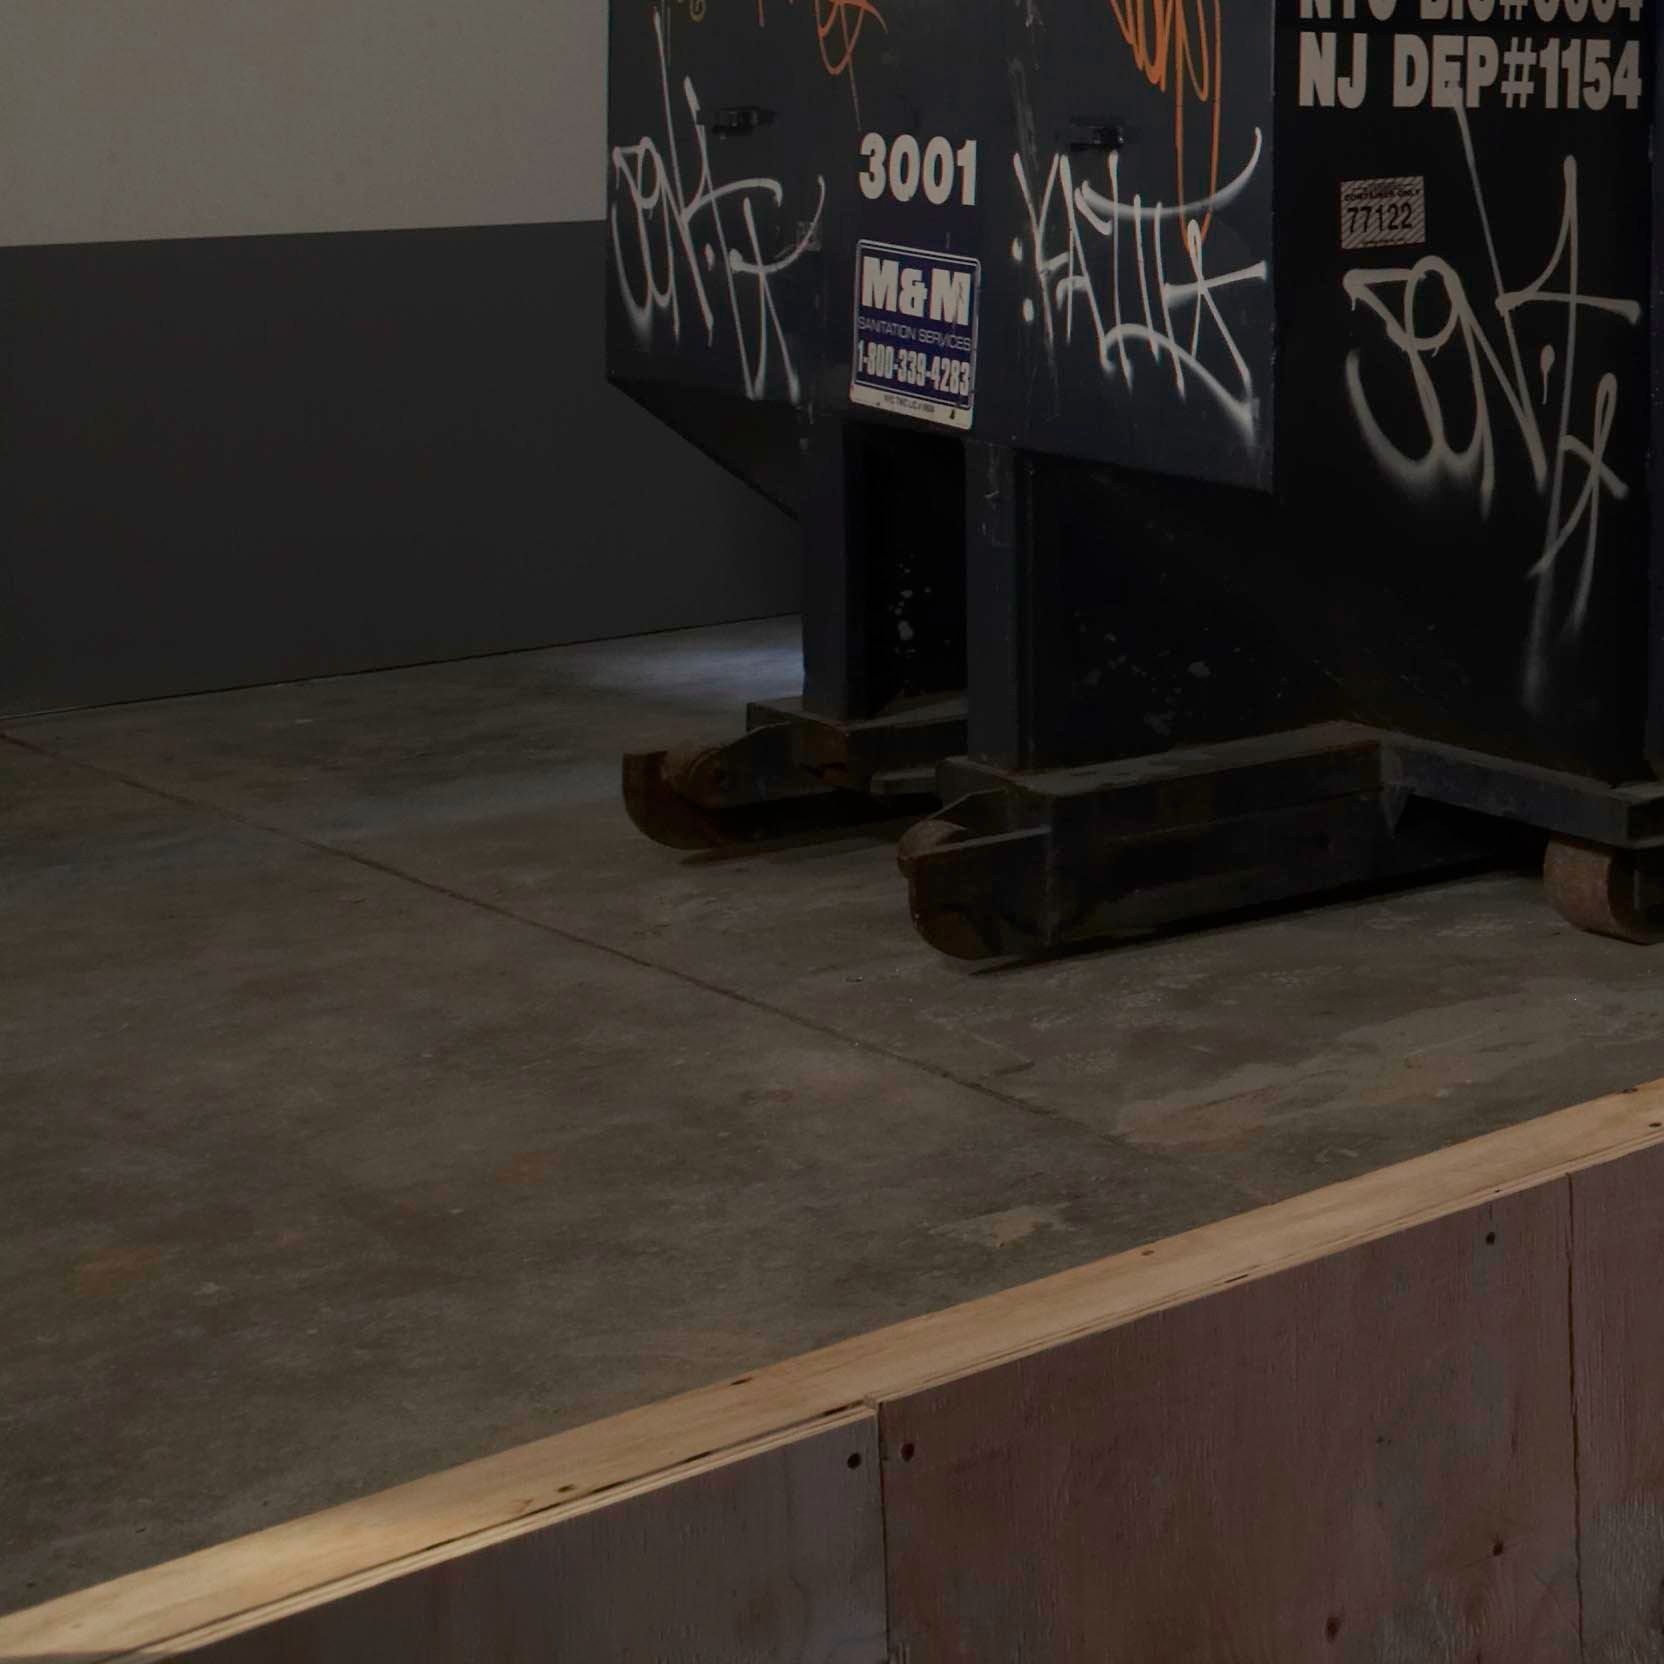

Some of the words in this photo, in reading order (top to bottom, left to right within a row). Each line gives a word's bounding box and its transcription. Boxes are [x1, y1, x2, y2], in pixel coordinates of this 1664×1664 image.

[1299, 31, 1367, 109] NJ
[1393, 33, 1642, 110] DEP#1154
[860, 133, 978, 206] 3001
[1347, 202, 1413, 235] 77122
[862, 256, 971, 326] M&M
[857, 316, 917, 341] SANITATION
[920, 328, 972, 352] SERVICES
[858, 339, 970, 396] 1-800-339-4283
